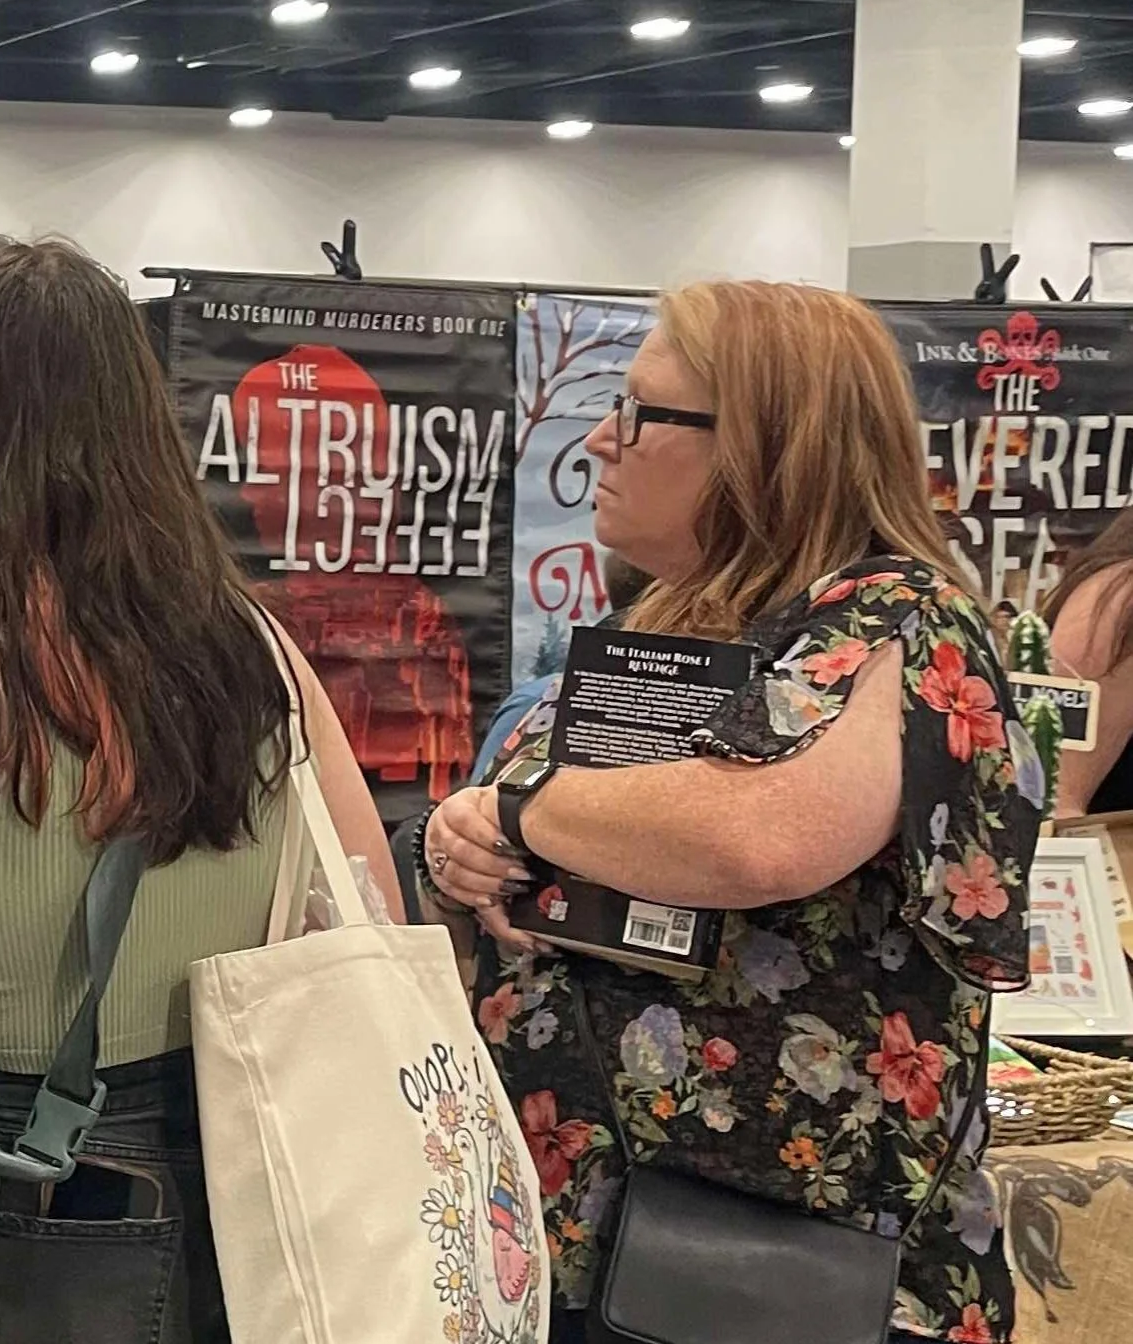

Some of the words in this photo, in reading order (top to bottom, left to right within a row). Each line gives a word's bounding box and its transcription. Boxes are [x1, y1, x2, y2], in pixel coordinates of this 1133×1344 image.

[202, 302, 316, 327] MASTERMIND
[323, 311, 426, 333] MURDERERS
[432, 316, 476, 334] BOOK
[479, 319, 506, 337] ONE
[957, 342, 978, 363] &
[277, 362, 320, 391] THE
[993, 372, 1041, 412] THE
[196, 394, 506, 498] ALTRUISM
[920, 414, 1133, 510] EVERED
[605, 645, 626, 657] THE
[628, 647, 672, 662] ITALIAN
[673, 653, 703, 666] ROSE
[628, 660, 680, 676] REVENGE
